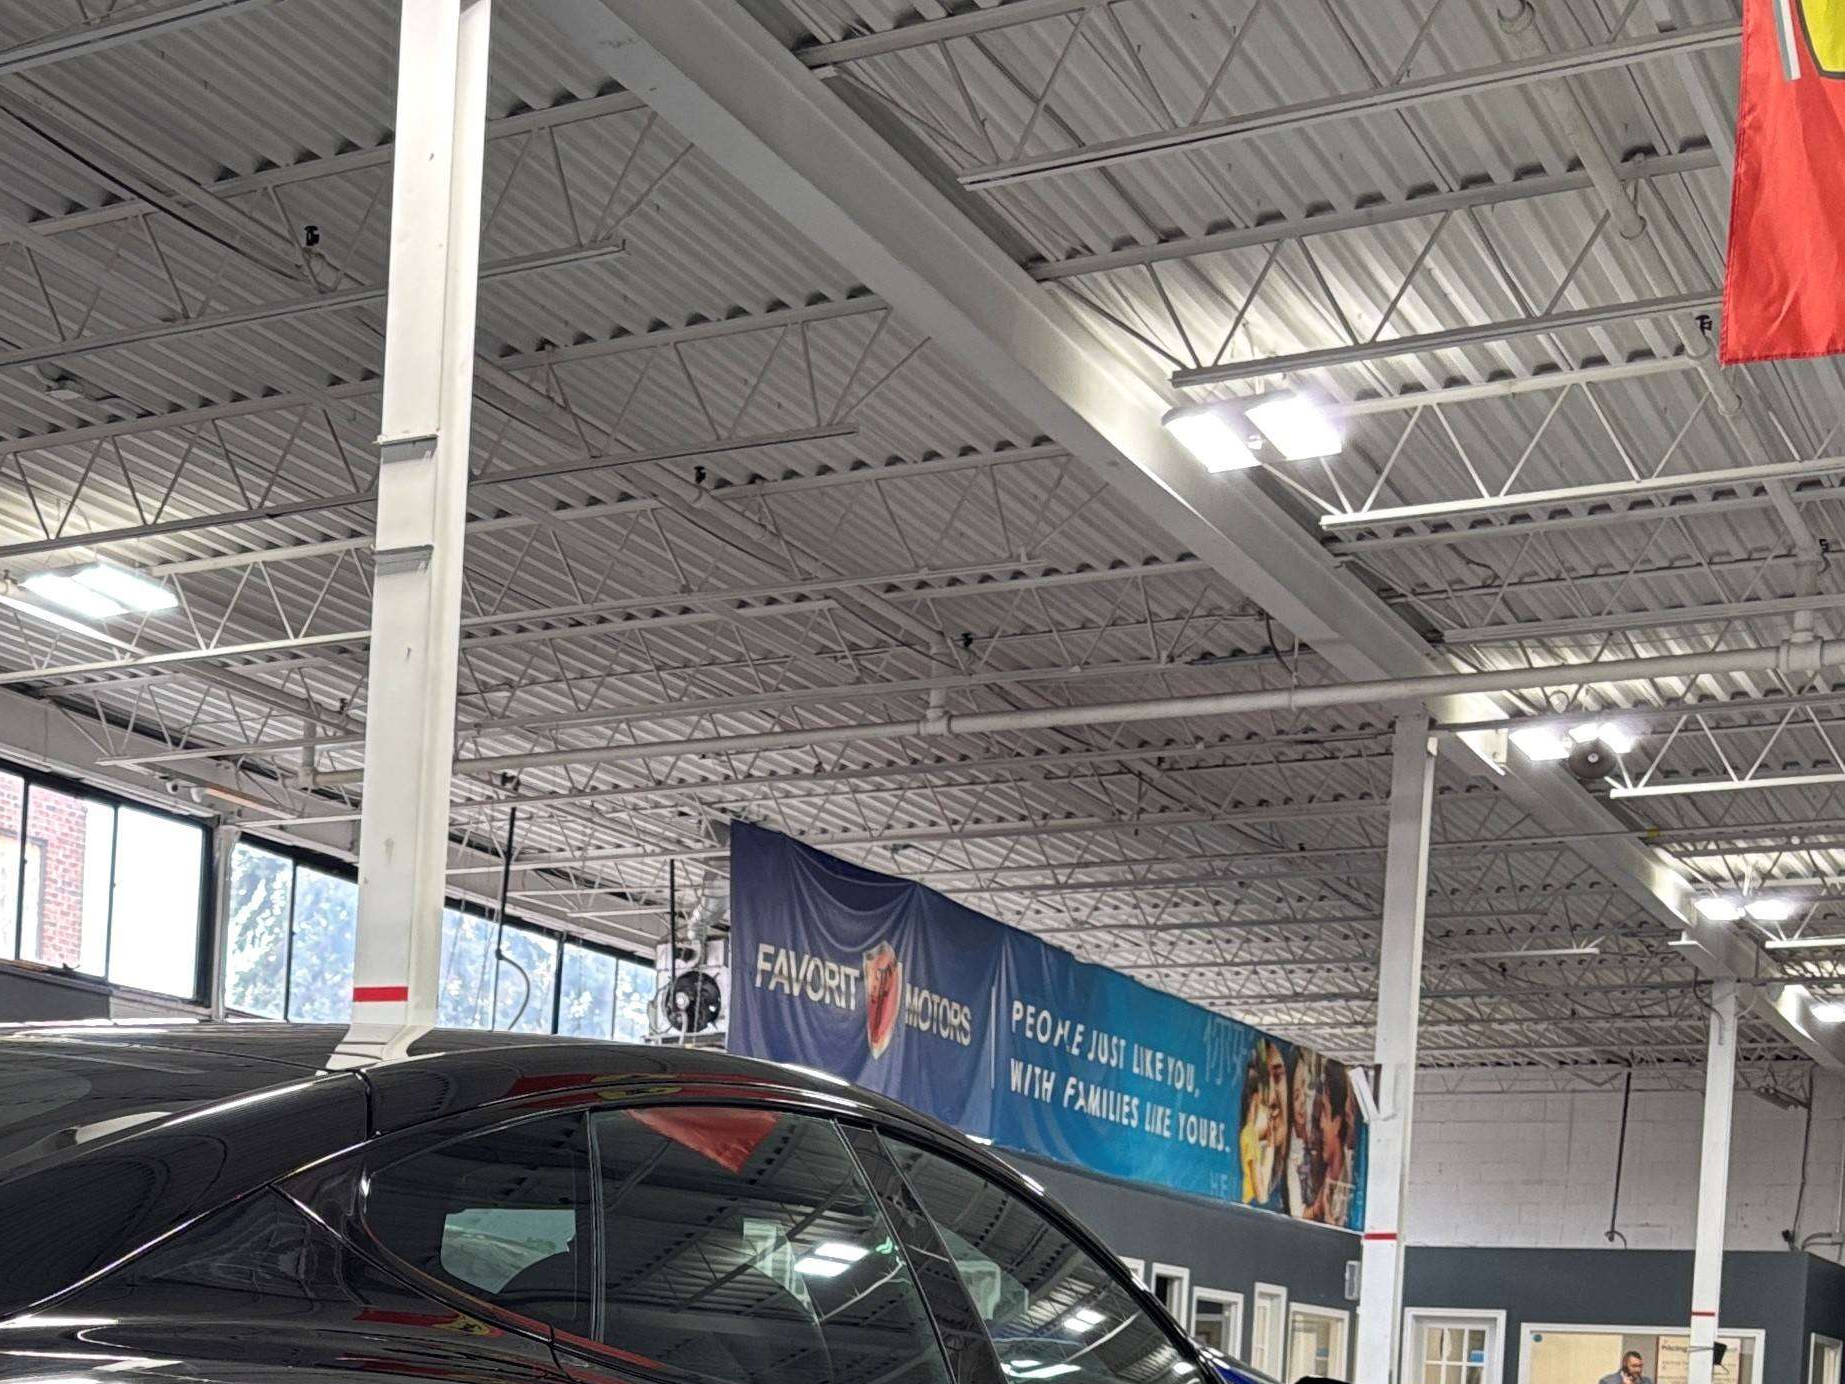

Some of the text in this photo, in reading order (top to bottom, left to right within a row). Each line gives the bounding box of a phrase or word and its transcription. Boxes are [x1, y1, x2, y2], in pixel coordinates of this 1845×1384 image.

[755, 943, 972, 1046] FAVORIT MOTORS
[1087, 1030, 1126, 1070] JUST
[1132, 1044, 1164, 1082] LIKE
[1010, 1058, 1231, 1153] WITH FAMILIES LIKE YOURS.
